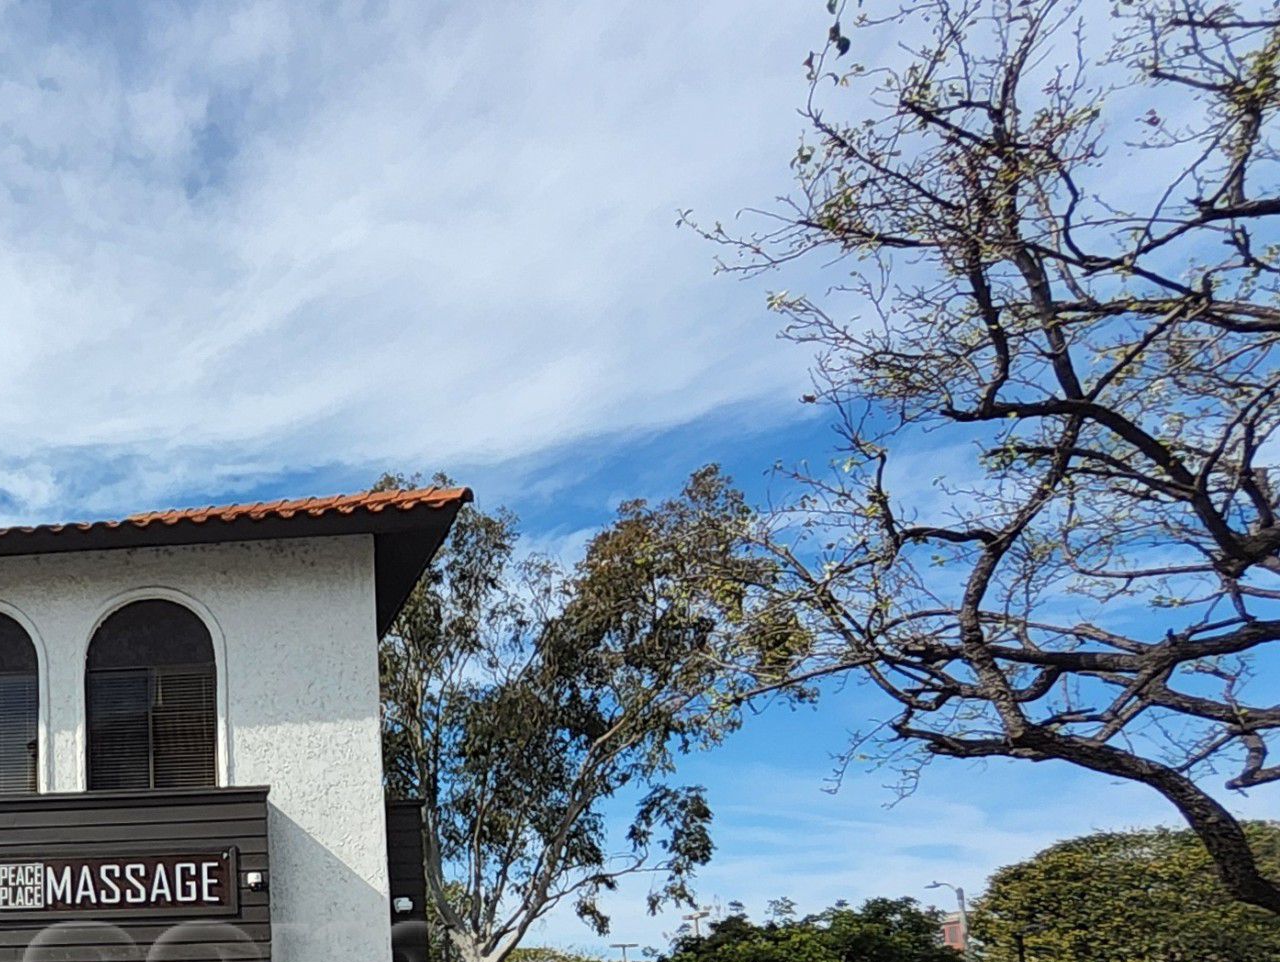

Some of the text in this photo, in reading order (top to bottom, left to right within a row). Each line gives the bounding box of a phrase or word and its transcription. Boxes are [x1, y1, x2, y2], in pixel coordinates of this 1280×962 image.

[0, 865, 42, 886] PEACE
[46, 862, 220, 905] MASSAGE
[0, 886, 42, 907] PLACE
